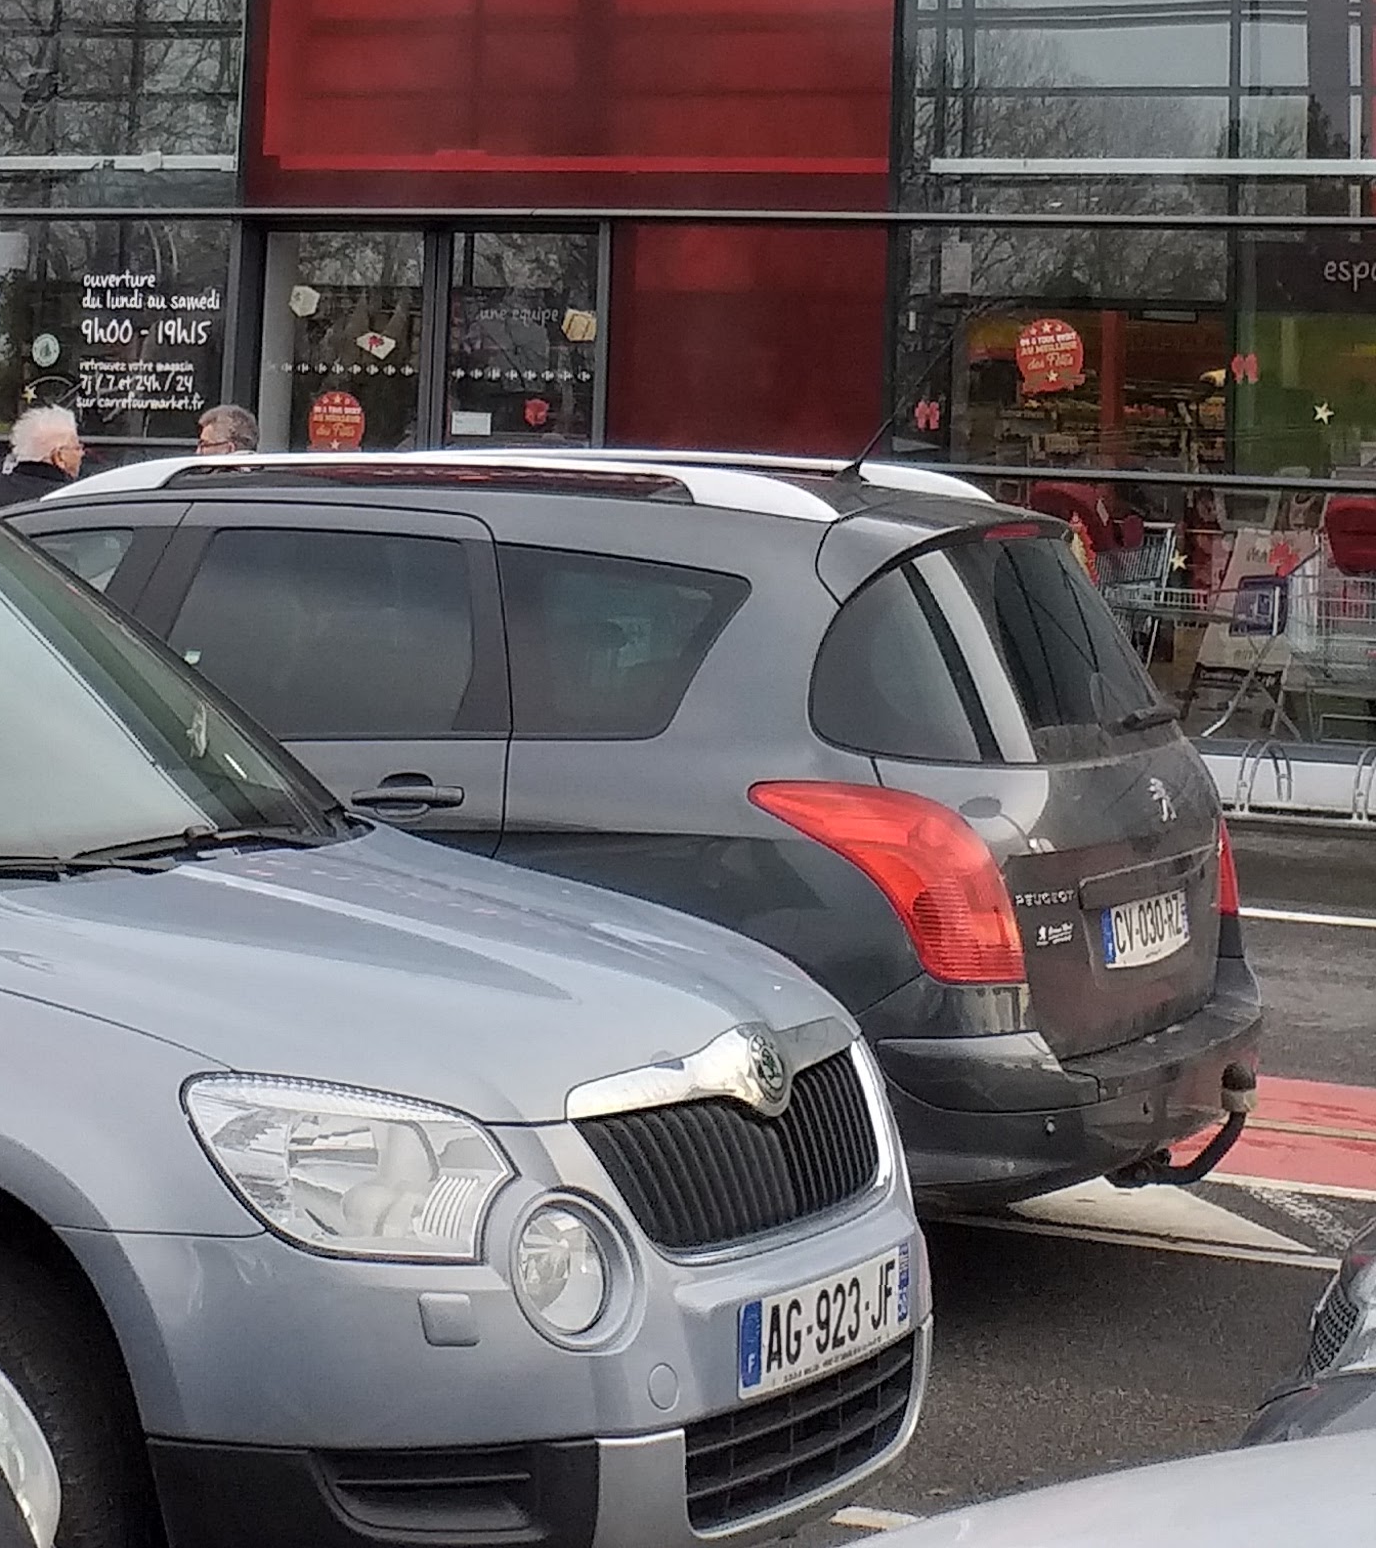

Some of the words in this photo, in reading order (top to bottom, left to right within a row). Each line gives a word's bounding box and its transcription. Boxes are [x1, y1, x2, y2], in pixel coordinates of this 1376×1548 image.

[83, 269, 156, 288] ouverture
[82, 288, 103, 309] du
[106, 288, 143, 309] lundi
[147, 295, 167, 309] au
[170, 289, 221, 310] samedi
[81, 317, 133, 345] 9h00
[157, 318, 212, 345] 19h15
[79, 359, 126, 371] retrouvez
[128, 359, 153, 372] votre
[135, 374, 161, 392] 24h
[176, 375, 193, 393] 24
[76, 396, 95, 408] sur
[1015, 889, 1074, 907] PEUGEOT
[766, 1258, 896, 1374] AG-923-JF
